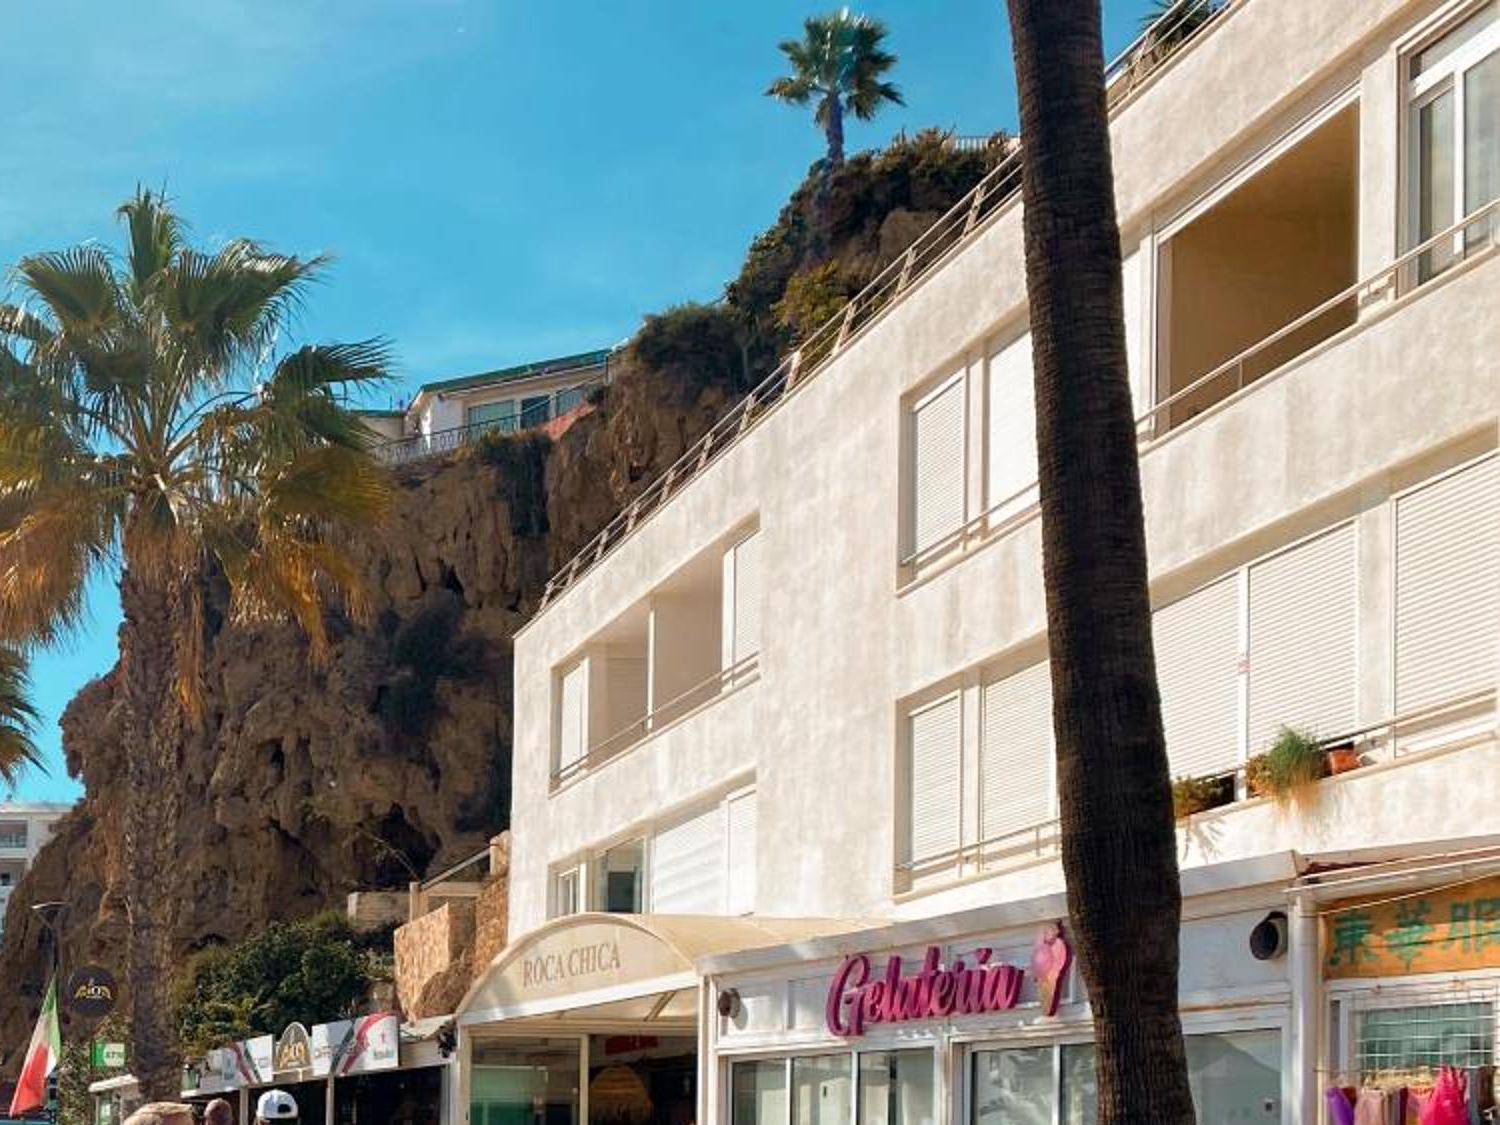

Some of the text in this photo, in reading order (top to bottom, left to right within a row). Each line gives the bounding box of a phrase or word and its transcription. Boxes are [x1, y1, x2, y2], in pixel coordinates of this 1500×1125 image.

[523, 943, 620, 987] ROCA CHICA
[826, 947, 1024, 1036] Gelateria
